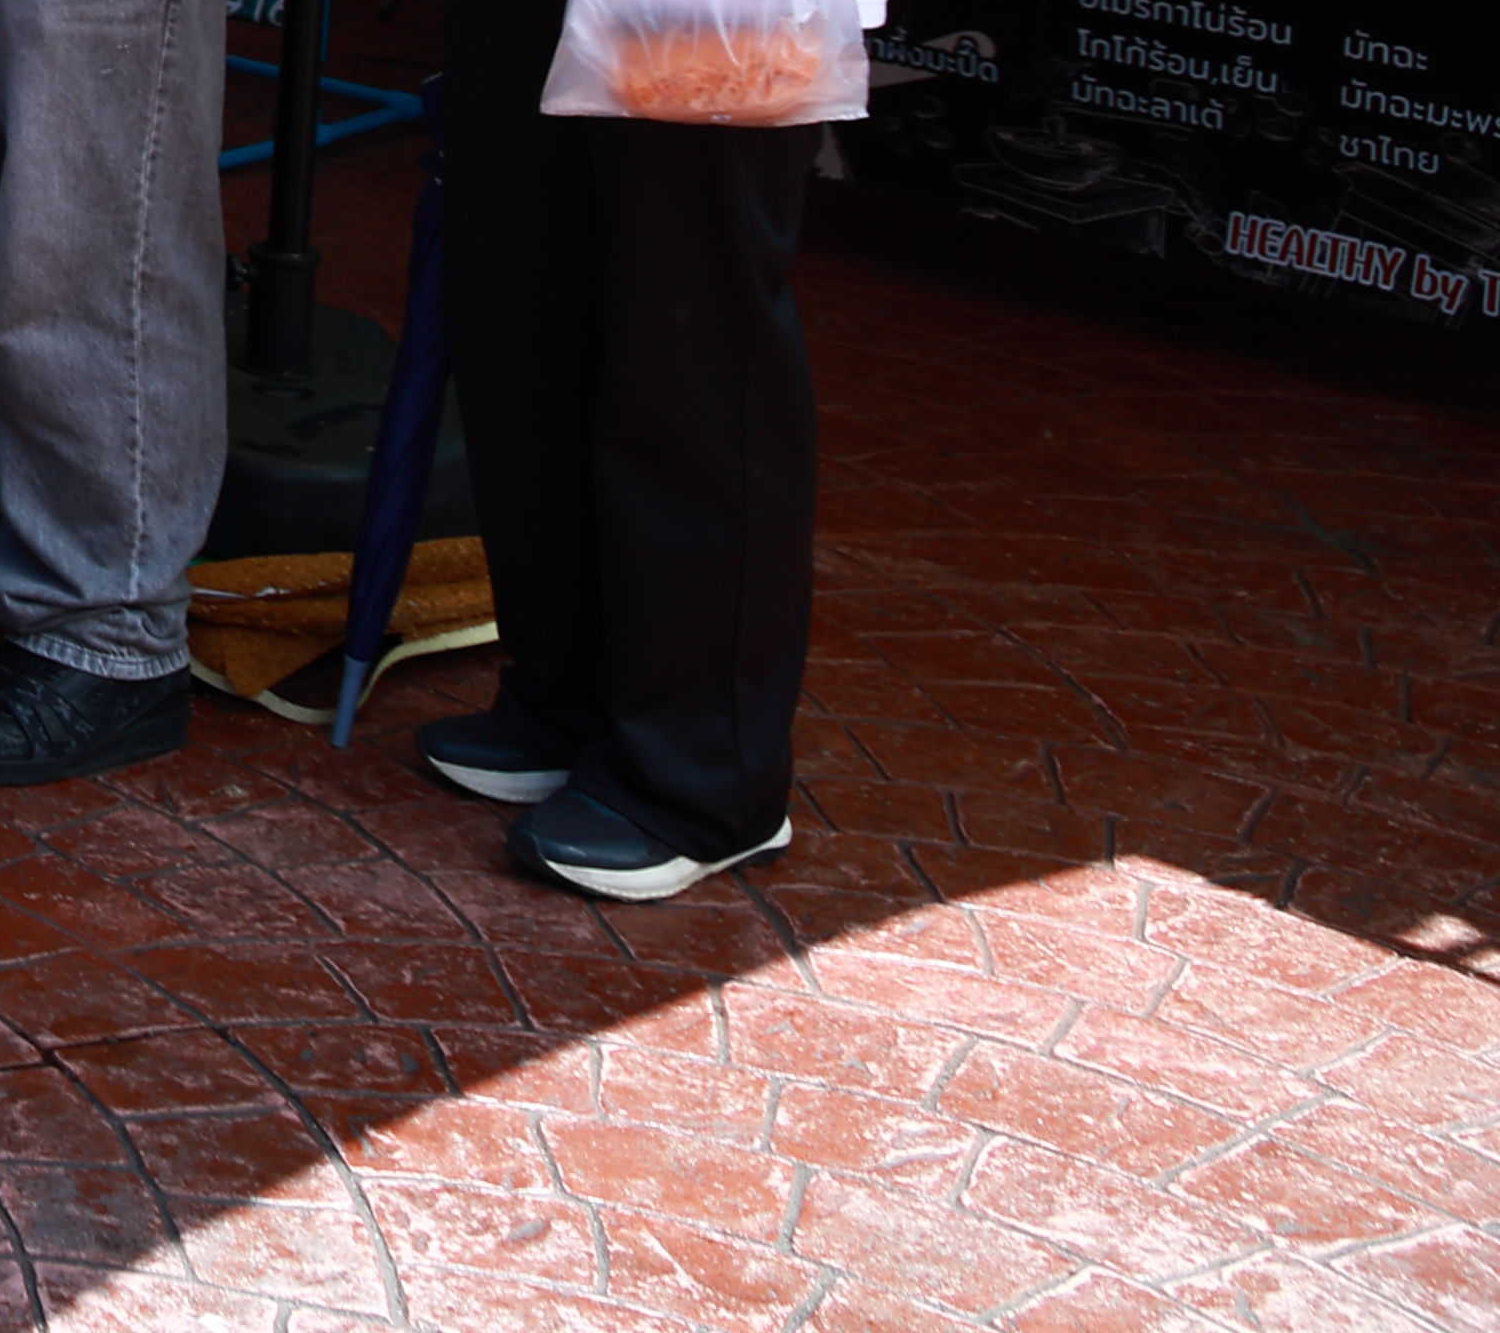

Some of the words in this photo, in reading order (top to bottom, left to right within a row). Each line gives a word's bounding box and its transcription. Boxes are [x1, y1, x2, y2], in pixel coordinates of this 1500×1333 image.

[1342, 27, 1429, 72] มัทฉะ
[1338, 133, 1441, 175] ชาไทย
[1225, 210, 1406, 292] HEALTHY
[1410, 252, 1469, 316] by
